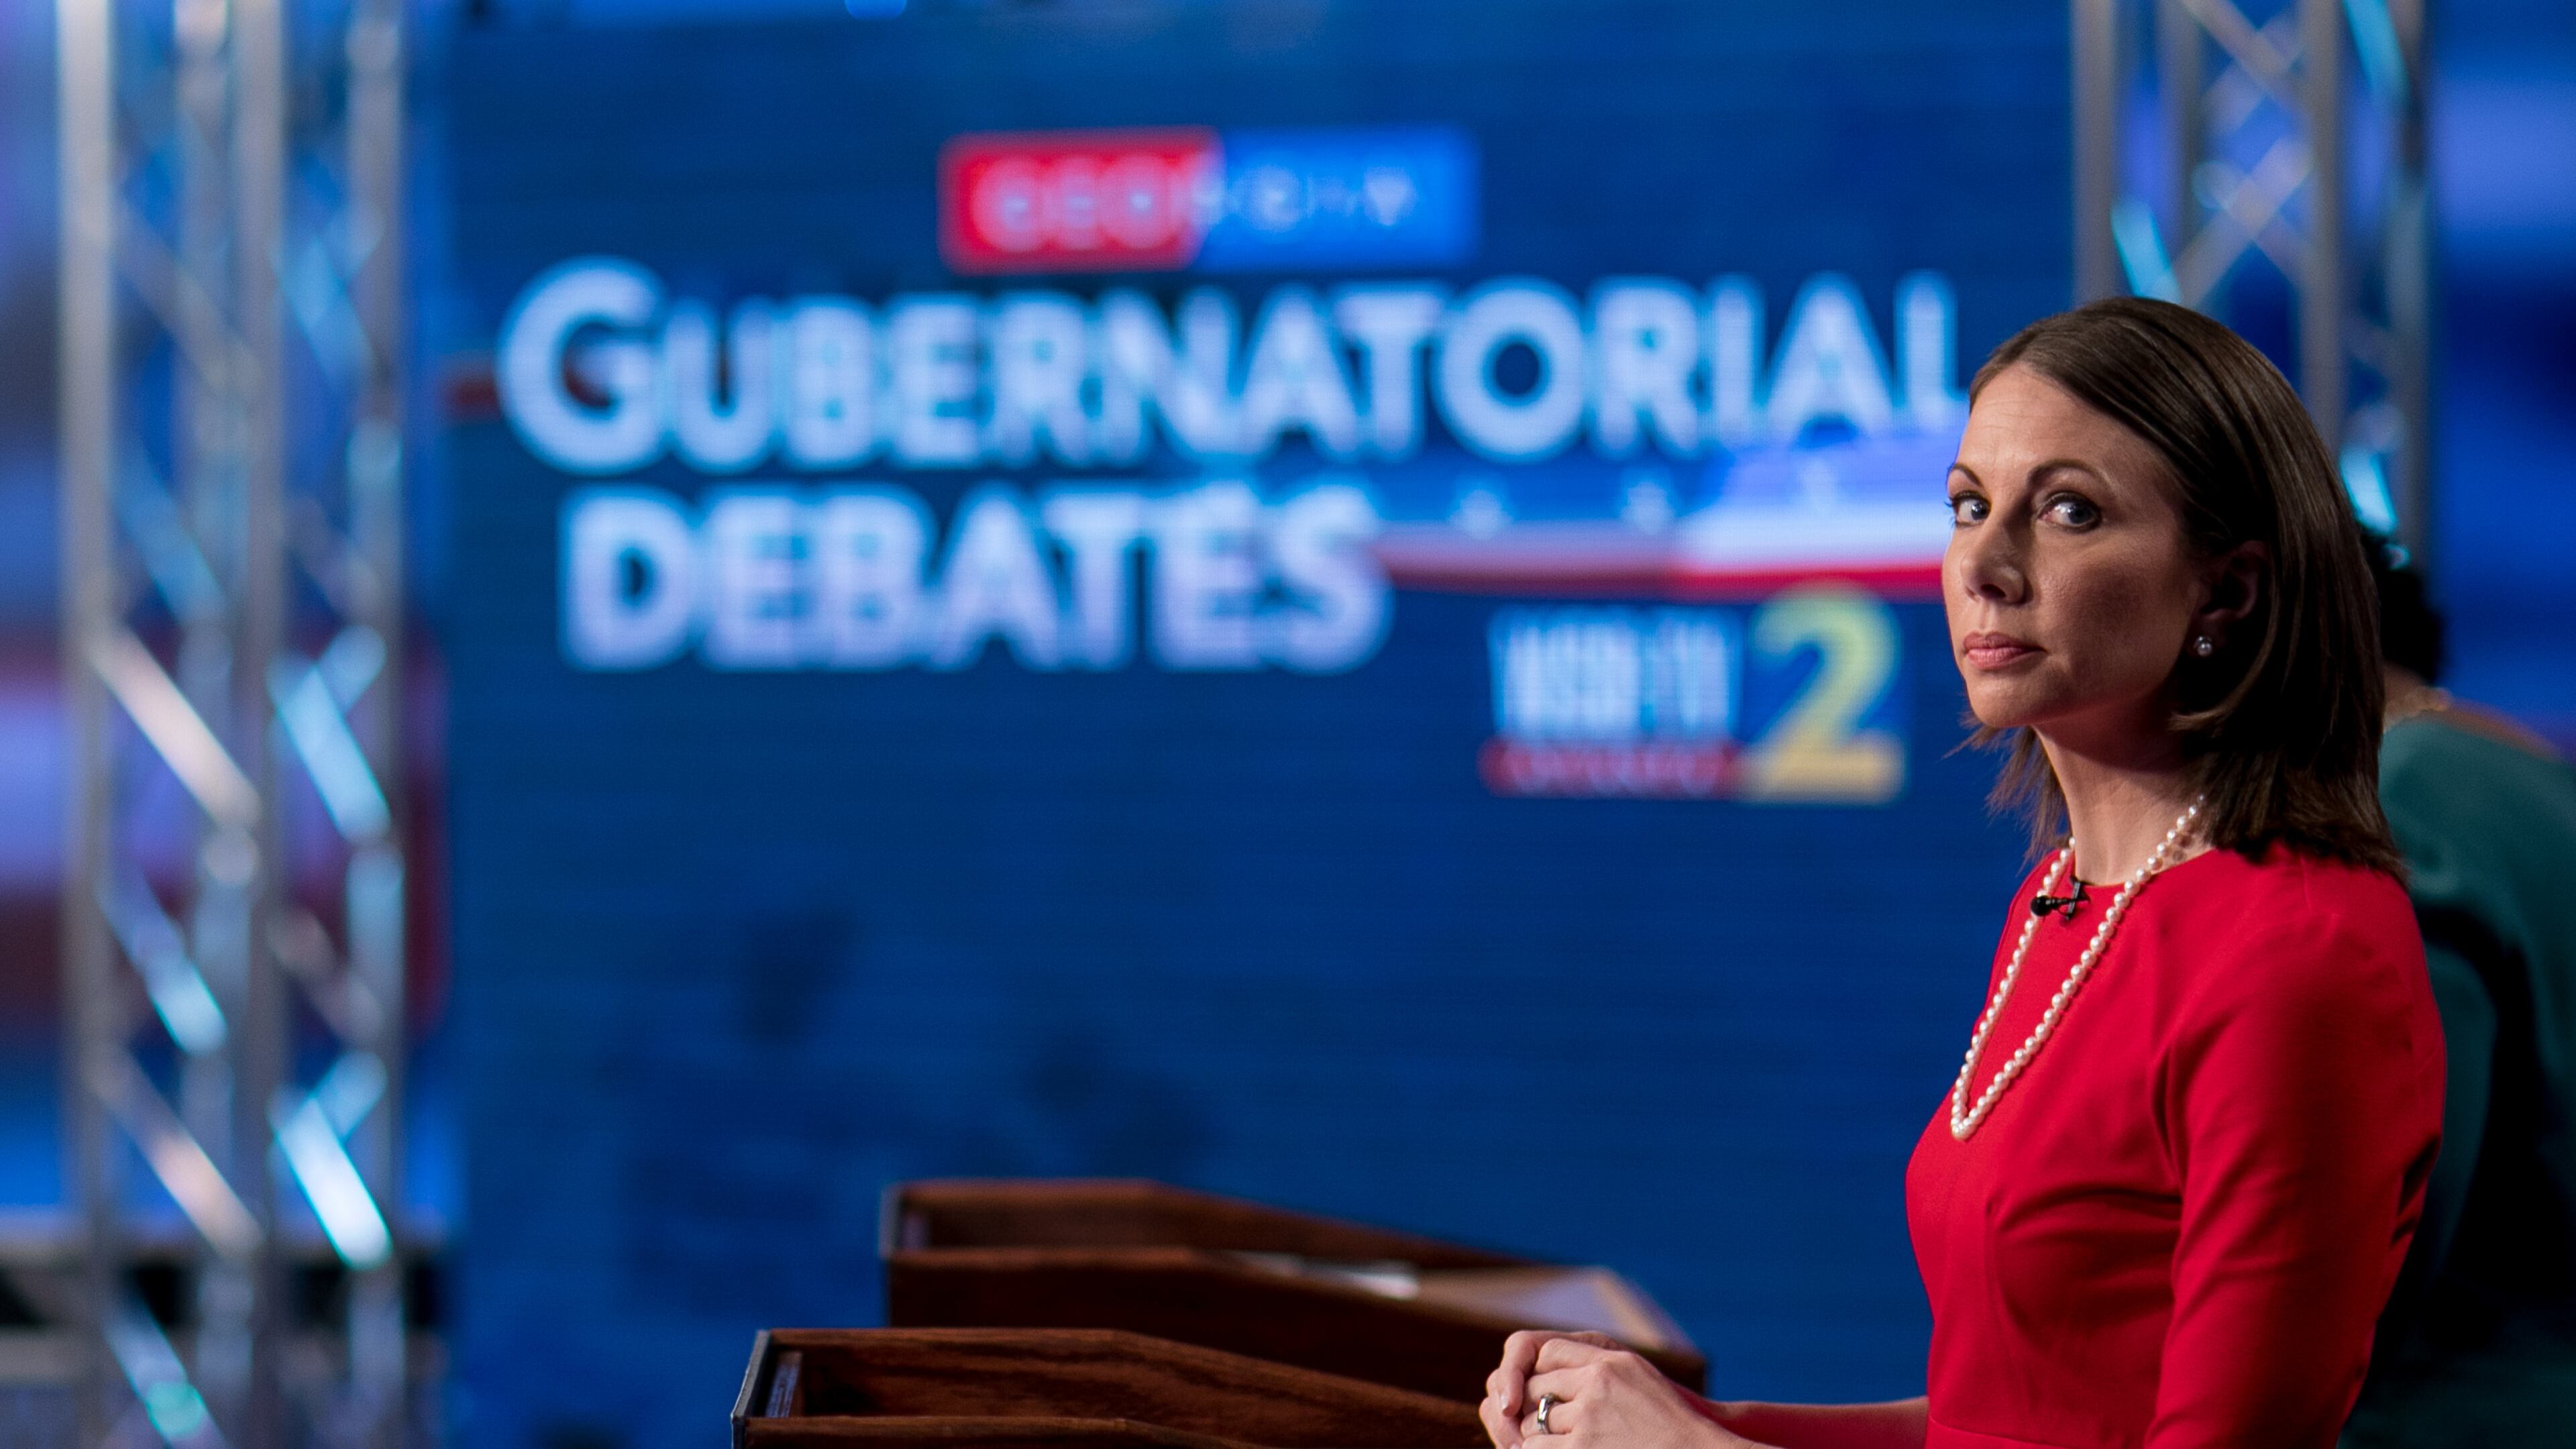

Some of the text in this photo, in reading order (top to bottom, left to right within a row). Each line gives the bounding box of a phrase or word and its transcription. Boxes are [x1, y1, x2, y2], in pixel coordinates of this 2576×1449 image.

[500, 258, 1966, 473] GUBERNATORIAL
[559, 480, 1394, 672] DEBATES
[1748, 582, 1907, 802] 2
